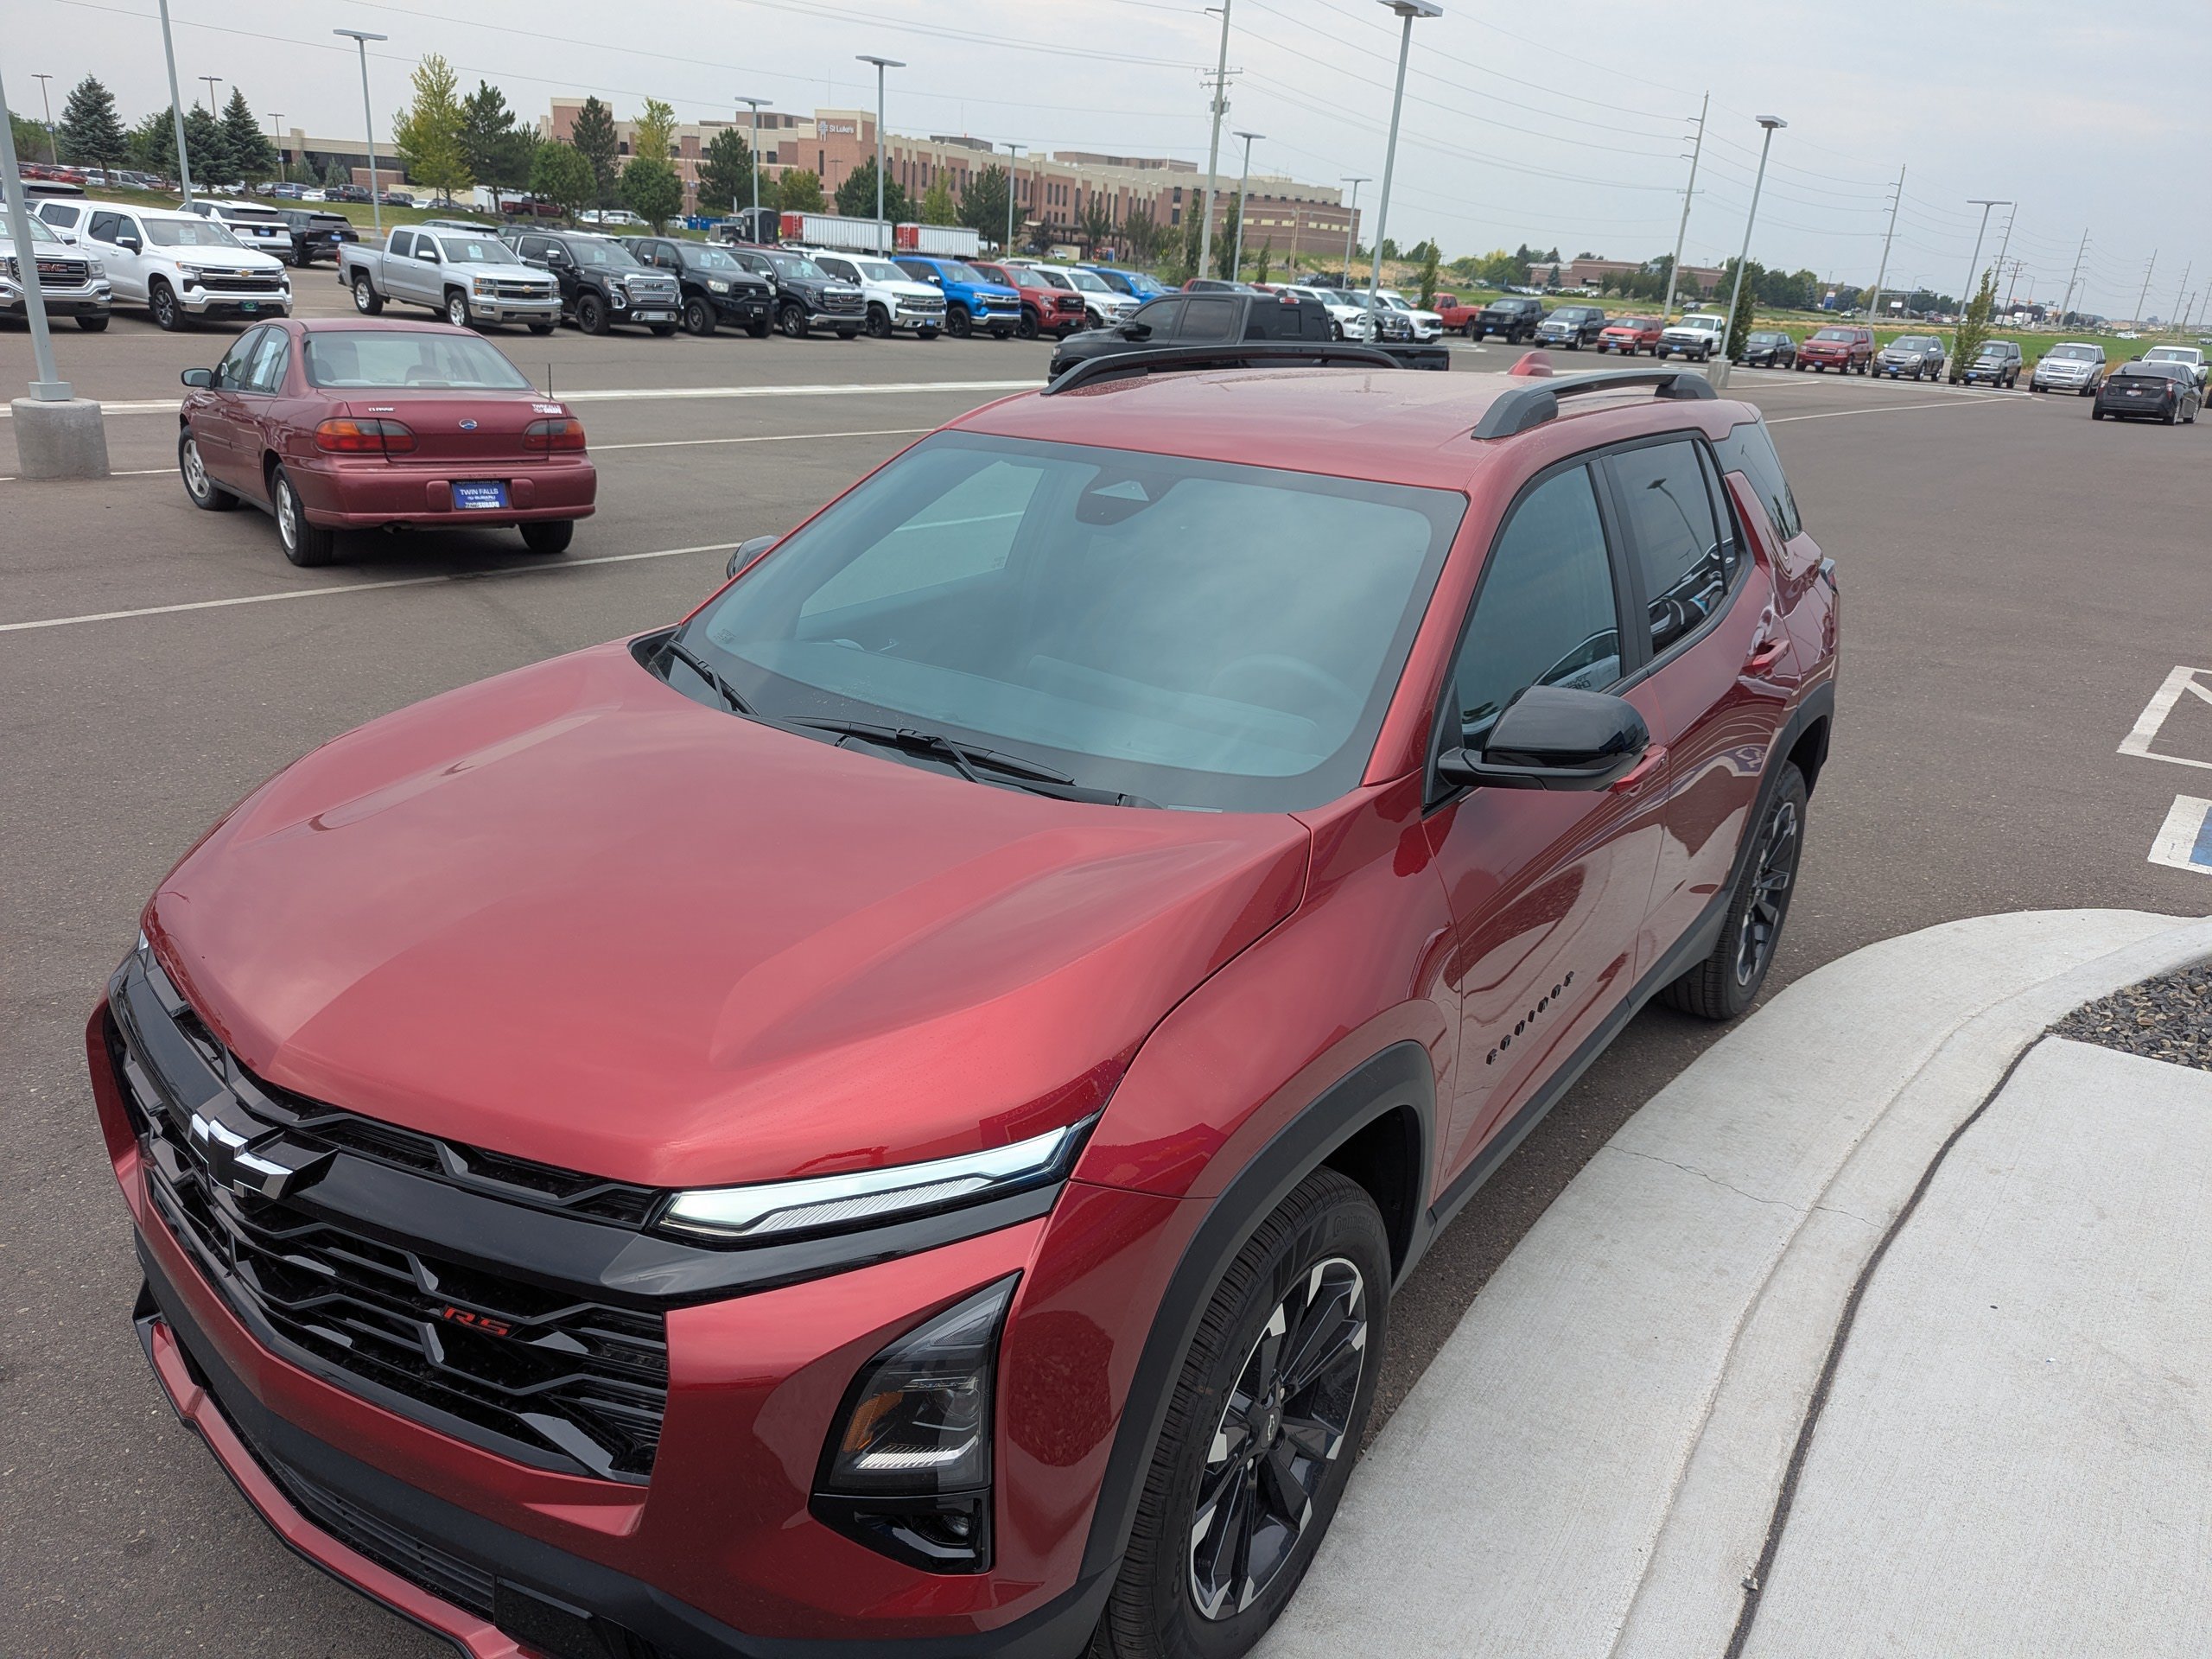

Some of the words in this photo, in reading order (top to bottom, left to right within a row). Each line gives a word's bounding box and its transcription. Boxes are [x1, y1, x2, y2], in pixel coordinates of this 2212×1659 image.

[830, 124, 836, 133] St
[36, 263, 68, 272] GMC
[444, 1306, 512, 1336] RS
